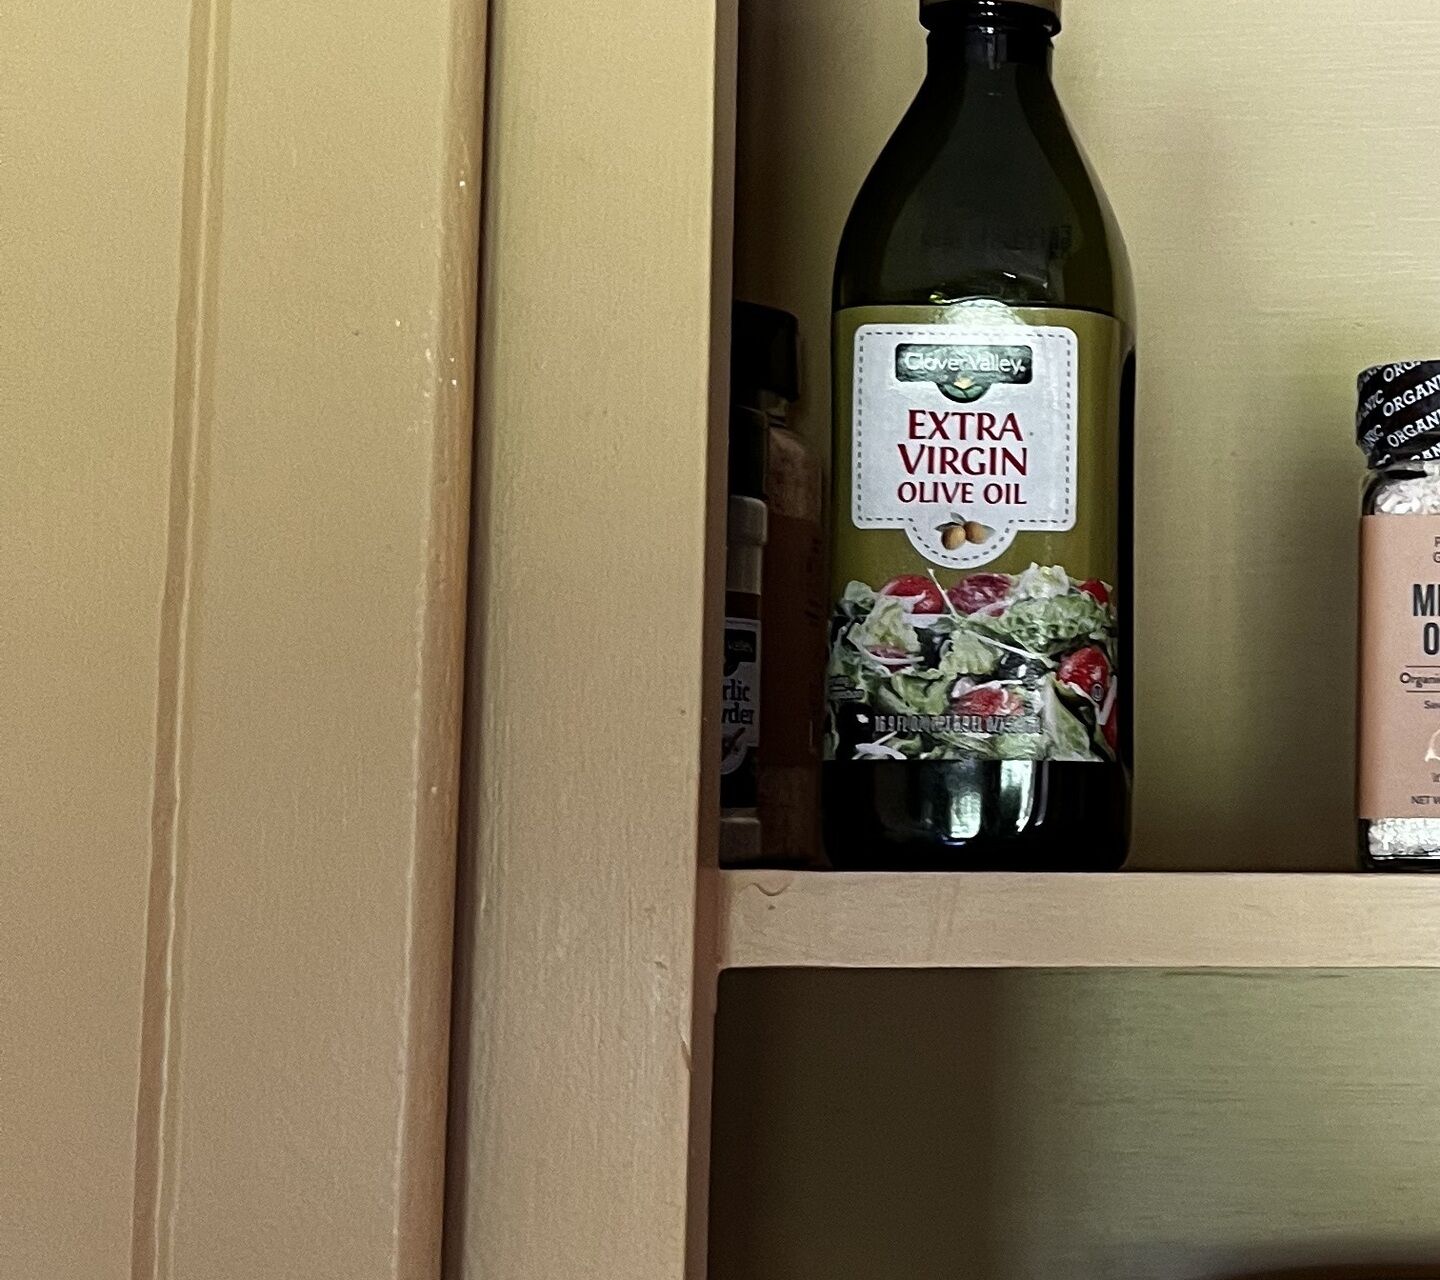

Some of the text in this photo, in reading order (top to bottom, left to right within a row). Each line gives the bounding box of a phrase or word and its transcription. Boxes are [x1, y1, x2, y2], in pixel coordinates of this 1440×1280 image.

[908, 409, 1024, 442] EXTRA
[897, 443, 1028, 477] VIRGIN
[897, 481, 1028, 505] OLIVE OIL
[722, 678, 751, 702] rlic
[1411, 795, 1431, 805] NET
